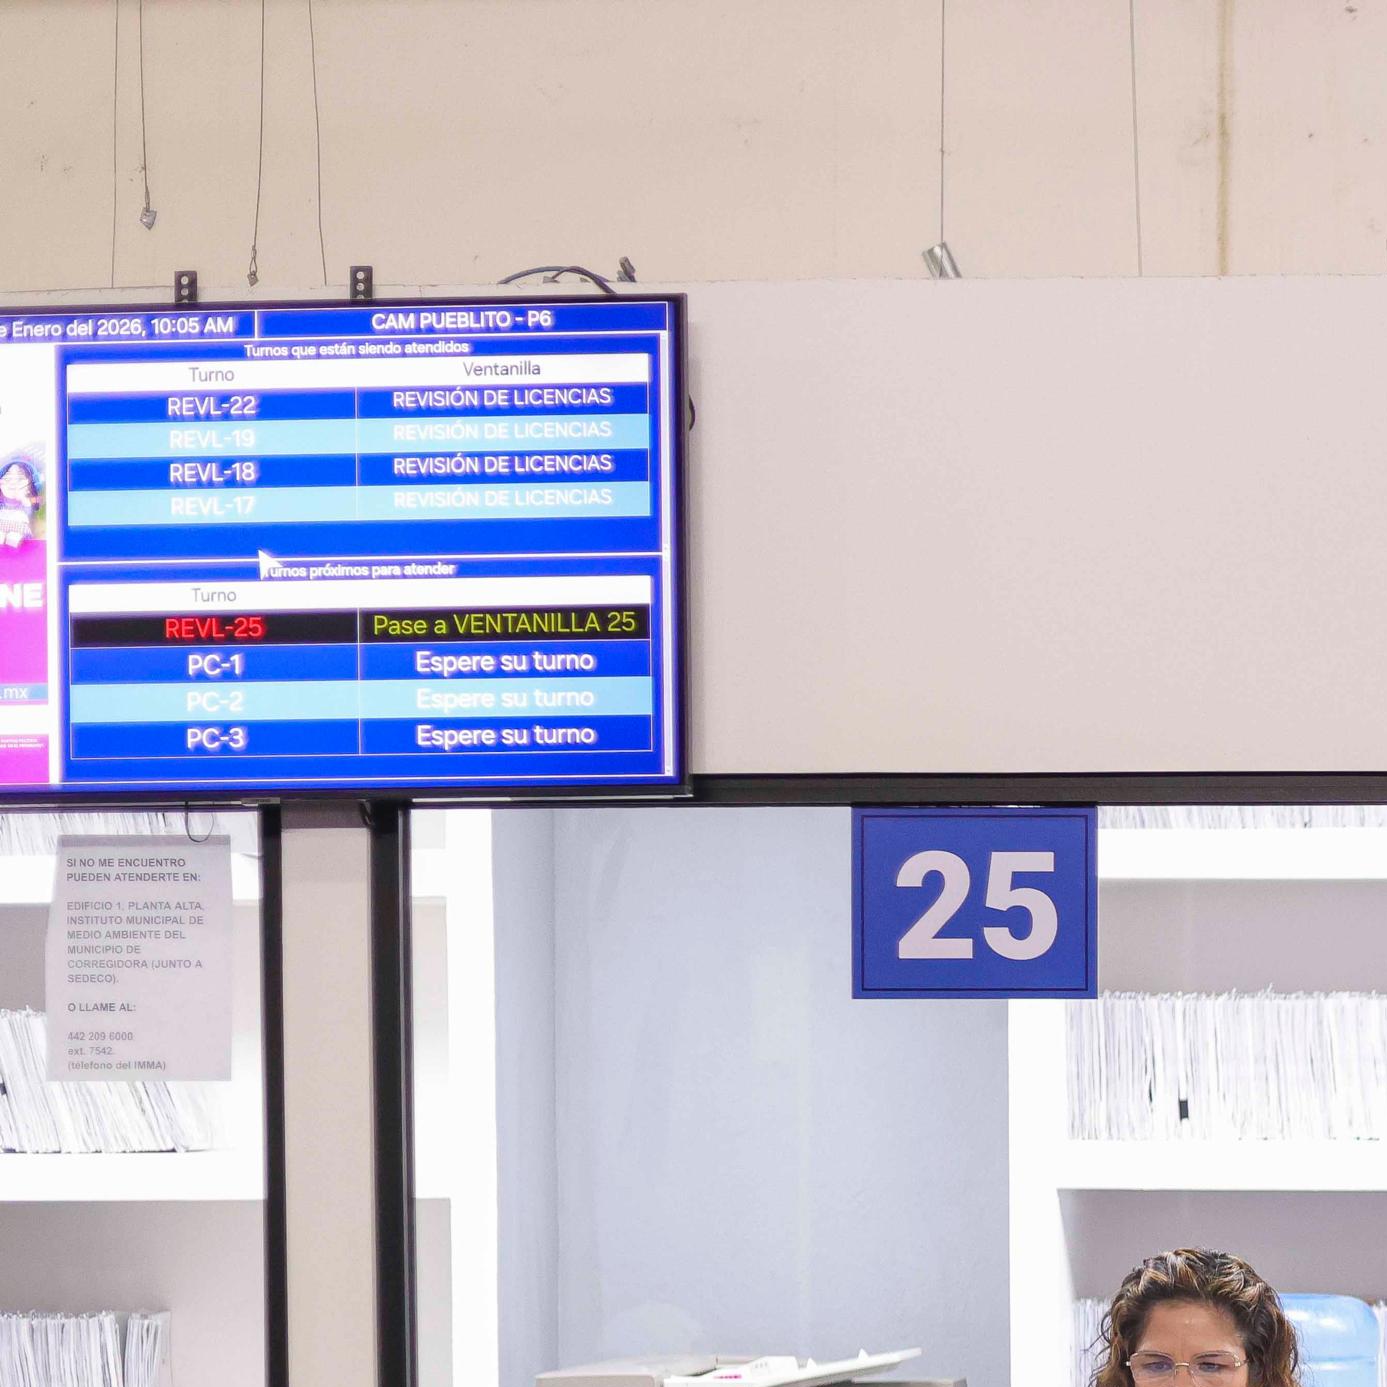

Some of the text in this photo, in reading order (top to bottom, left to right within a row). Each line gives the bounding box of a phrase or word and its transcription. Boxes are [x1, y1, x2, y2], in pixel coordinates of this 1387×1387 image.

[12, 317, 234, 338] Enero del 2026, 10:05 AM
[371, 310, 552, 329] CAM PUEBLITO P6
[244, 339, 470, 360] Turnos que están siendo atendidos
[189, 360, 541, 382] Turno Ventanilla
[167, 396, 257, 416] REVL-22
[393, 386, 611, 407] REVISIÓN DE LICENCIAS
[169, 429, 256, 450] REVL-19
[393, 420, 613, 441] REVISIÓN DE LICENCIAS
[169, 462, 256, 482] REVL-18
[393, 453, 613, 475] REVISIÓN DE LICENCIAS
[170, 496, 256, 516] REVL-17
[393, 487, 613, 509] REVISIÓN DE LICENCIAS
[310, 561, 456, 579] próximos para atender
[192, 588, 237, 603] Turno
[165, 617, 263, 638] REVL-25
[373, 611, 636, 635] Pase a VENTANILLA 25
[187, 653, 241, 675] PC-1
[415, 650, 595, 676] Espere su turno
[186, 690, 244, 712] PC-2
[415, 687, 595, 713] Espere su turno
[186, 727, 245, 749] PC-3
[416, 724, 595, 751] Espere su turno
[66, 858, 186, 868] SI NO ME ENCUENTRO
[66, 872, 201, 882] PUEDEN ATENDERTE EN:
[67, 901, 172, 911] EDIFICIO PLANTA
[895, 849, 1059, 961] 25
[66, 915, 204, 925] INSTITUTO MUNICIPAL DE
[67, 930, 187, 940] MEDIO AMBIENTE DEL
[67, 945, 141, 954] MUNICIPIO DE
[67, 959, 203, 971] CORREGIDORA (JUNTO A
[67, 1002, 76, 1012] O
[79, 1002, 116, 1012] LLAME
[67, 1031, 86, 1041] 442
[116, 1060, 166, 1071] del IMMA)
